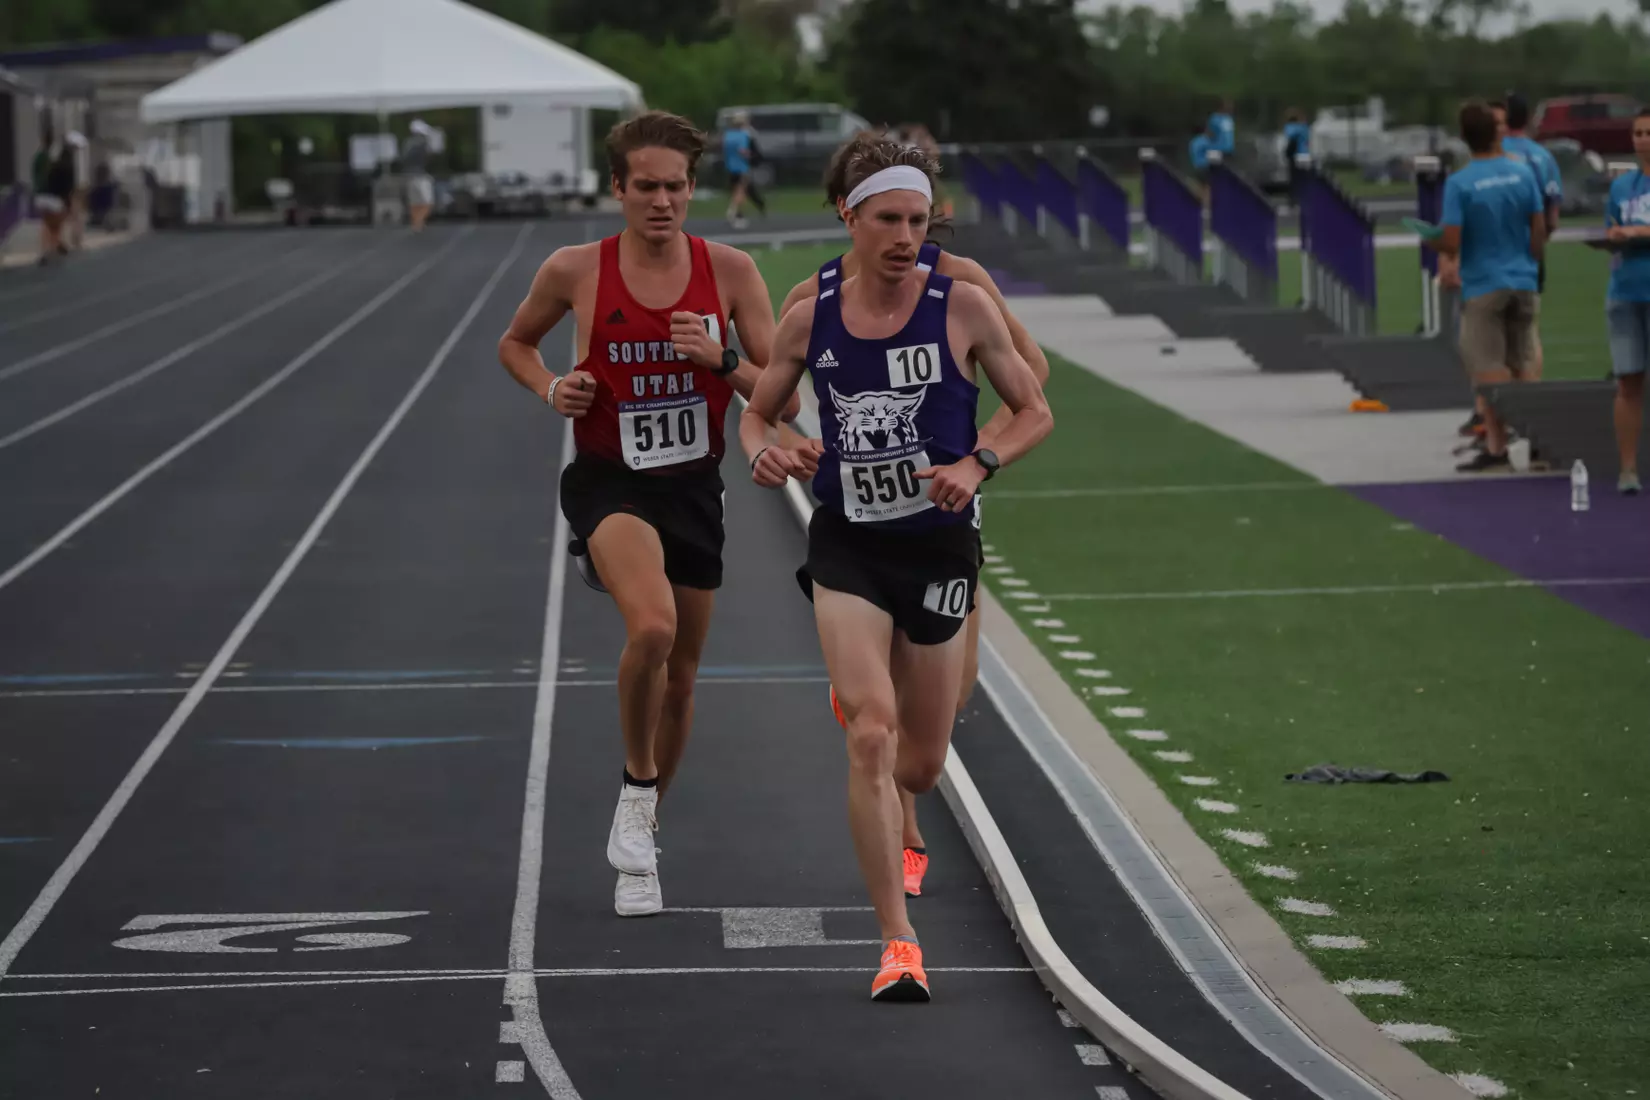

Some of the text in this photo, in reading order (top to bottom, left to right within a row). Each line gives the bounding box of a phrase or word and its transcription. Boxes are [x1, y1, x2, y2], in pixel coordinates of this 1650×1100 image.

[608, 341, 688, 364] SOUTH
[815, 360, 840, 369] adidas
[896, 346, 932, 384] 10
[632, 372, 694, 396] UTAH
[646, 399, 688, 408] CHAMPIONSHIPS
[633, 408, 696, 452] 510
[642, 454, 659, 462] WEBER
[660, 452, 675, 460] STATE
[861, 449, 904, 460] CHAMPIONSHIPS
[905, 445, 918, 453] 2021
[852, 459, 920, 505] 550
[937, 580, 966, 615] 10
